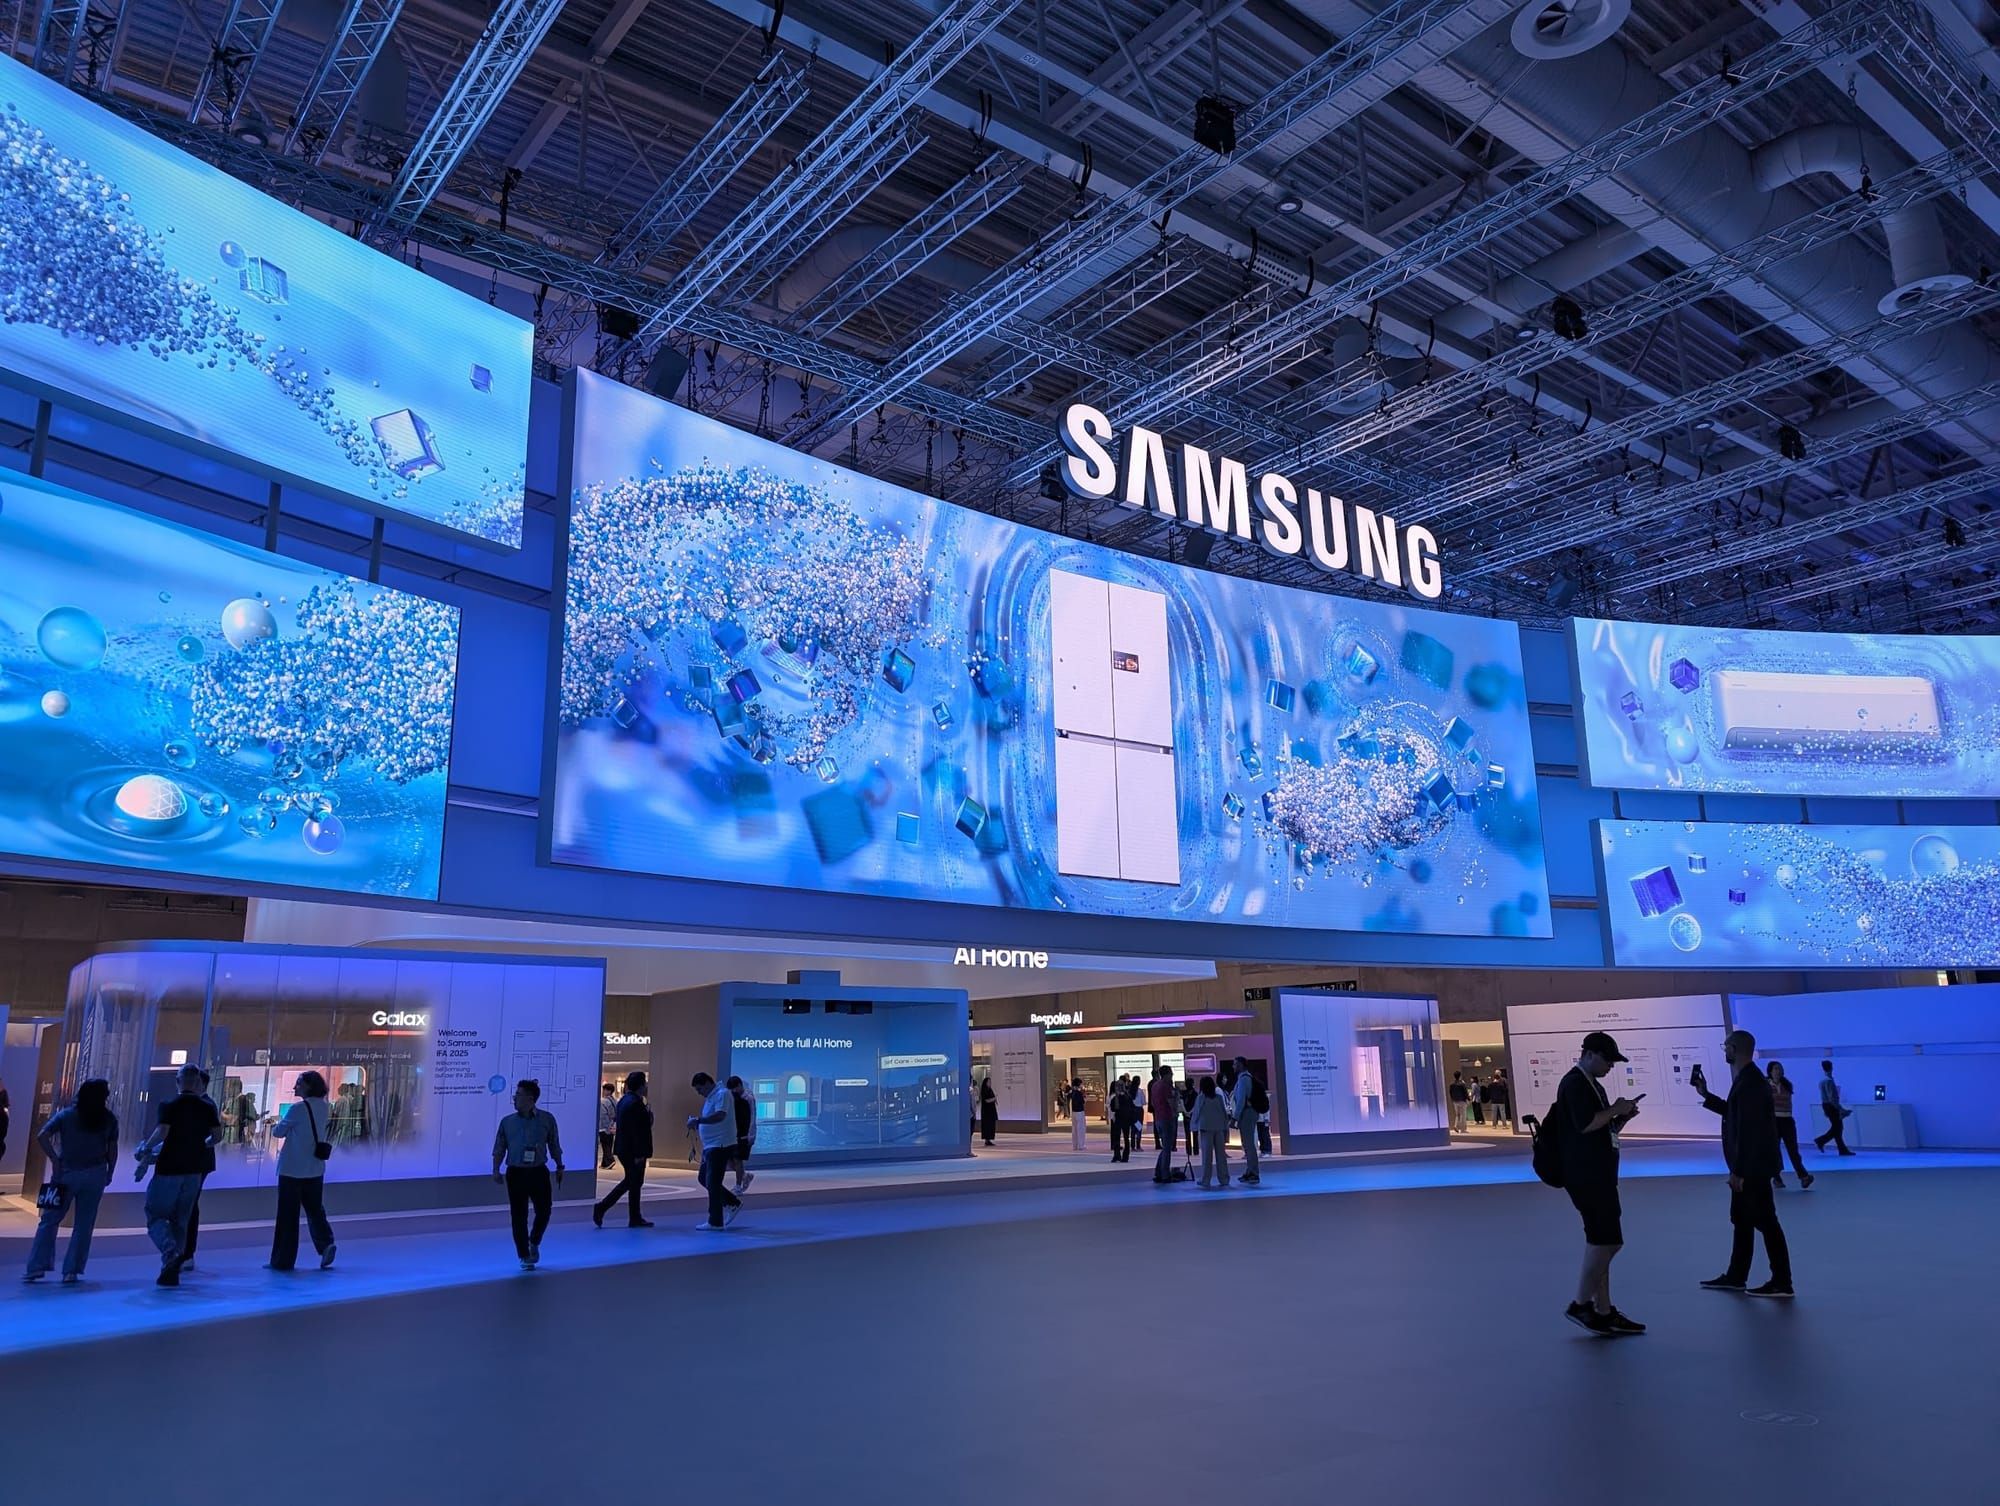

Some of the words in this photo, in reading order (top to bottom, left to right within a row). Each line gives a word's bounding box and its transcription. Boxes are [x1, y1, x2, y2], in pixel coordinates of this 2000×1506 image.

[1061, 404, 1442, 599] SAMSUNG
[953, 947, 976, 966] AI
[981, 948, 1049, 969] Home
[1030, 1011, 1072, 1029] Bespoke
[1072, 1011, 1083, 1024] AI
[438, 1029, 478, 1037] Welcome
[437, 1039, 446, 1047] to
[447, 1039, 487, 1049] Samsung
[777, 1038, 794, 1048] the
[796, 1037, 811, 1048] full
[812, 1038, 822, 1048] AI
[824, 1038, 853, 1049] Home
[436, 1049, 448, 1057] IFA
[449, 1049, 469, 1057] 2025
